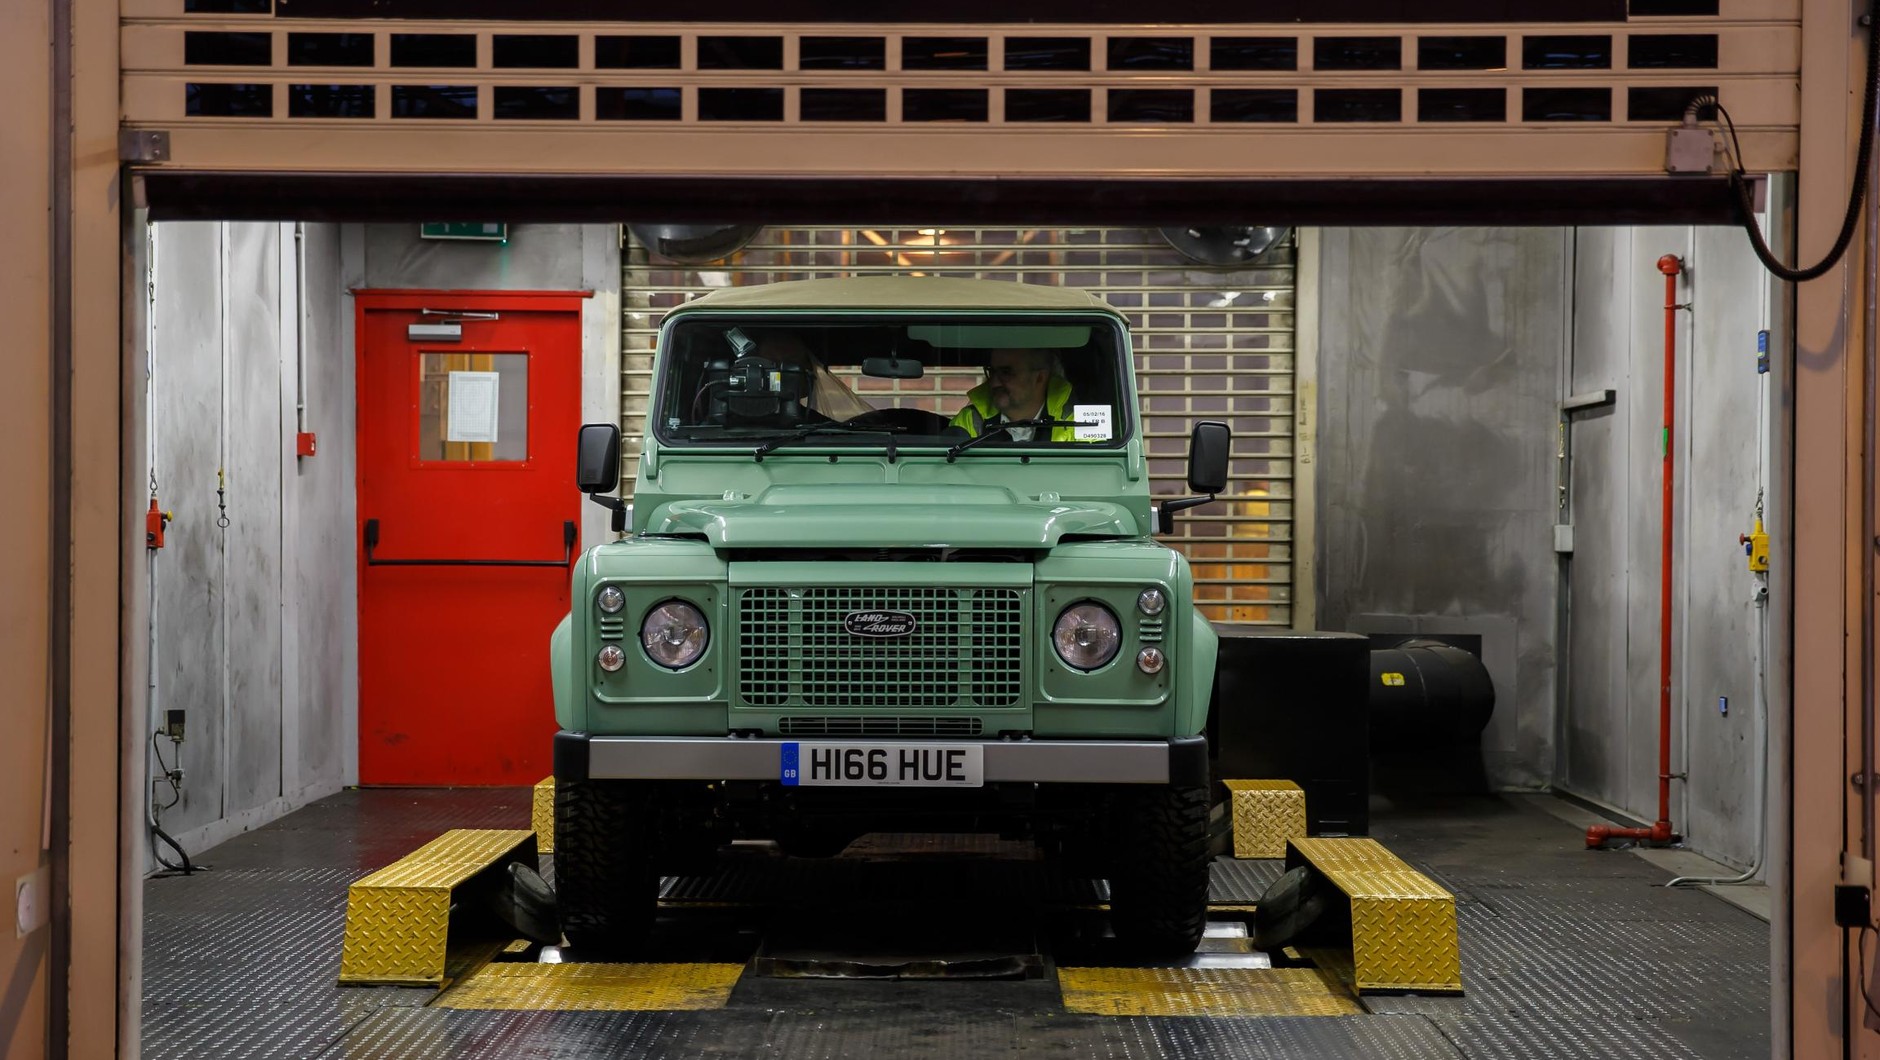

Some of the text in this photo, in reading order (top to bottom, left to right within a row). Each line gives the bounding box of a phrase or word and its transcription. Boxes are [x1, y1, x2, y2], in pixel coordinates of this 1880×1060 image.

[854, 614, 885, 622] LAND
[871, 624, 906, 632] ROVER
[899, 749, 966, 781] HUE
[784, 769, 797, 778] GB
